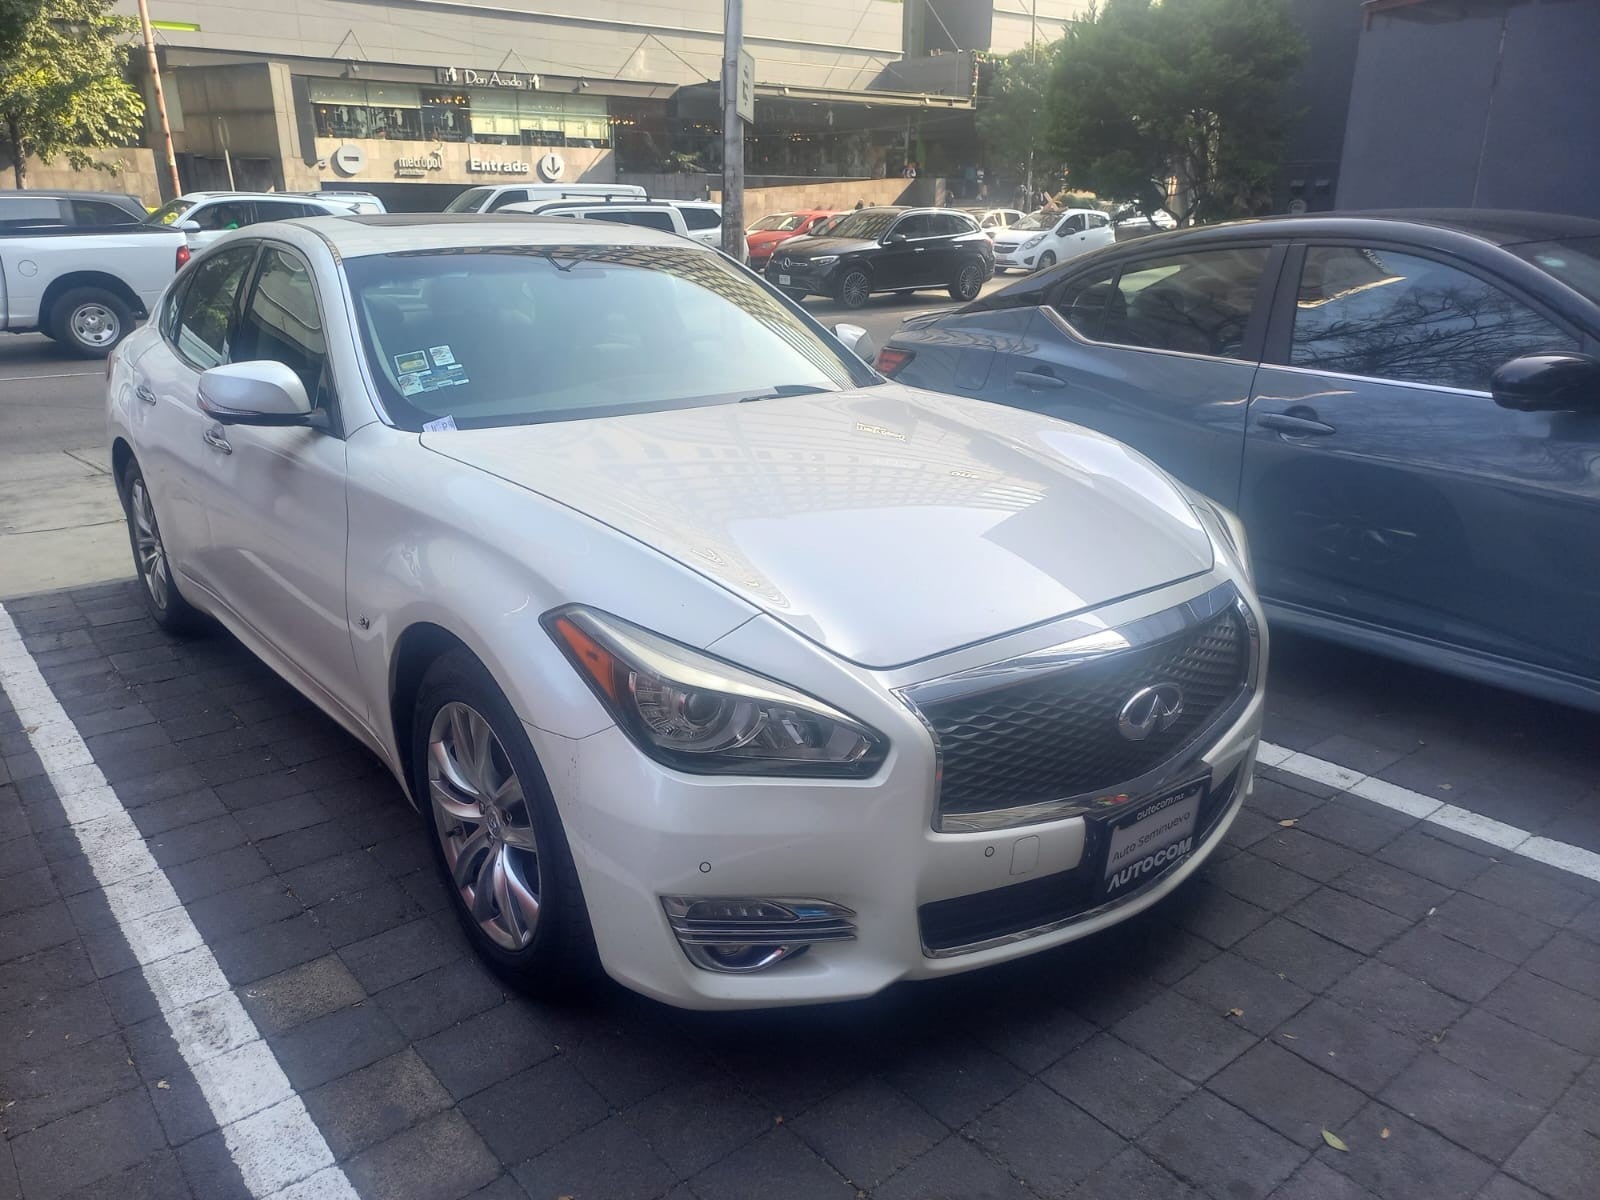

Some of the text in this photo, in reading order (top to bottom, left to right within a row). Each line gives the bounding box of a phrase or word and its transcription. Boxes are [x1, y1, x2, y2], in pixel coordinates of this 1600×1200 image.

[465, 69, 522, 86] Don Asado
[471, 160, 529, 172] Entrada
[1112, 812, 1191, 863] Auto Seminuevo
[1107, 837, 1193, 893] AUTOCOM
